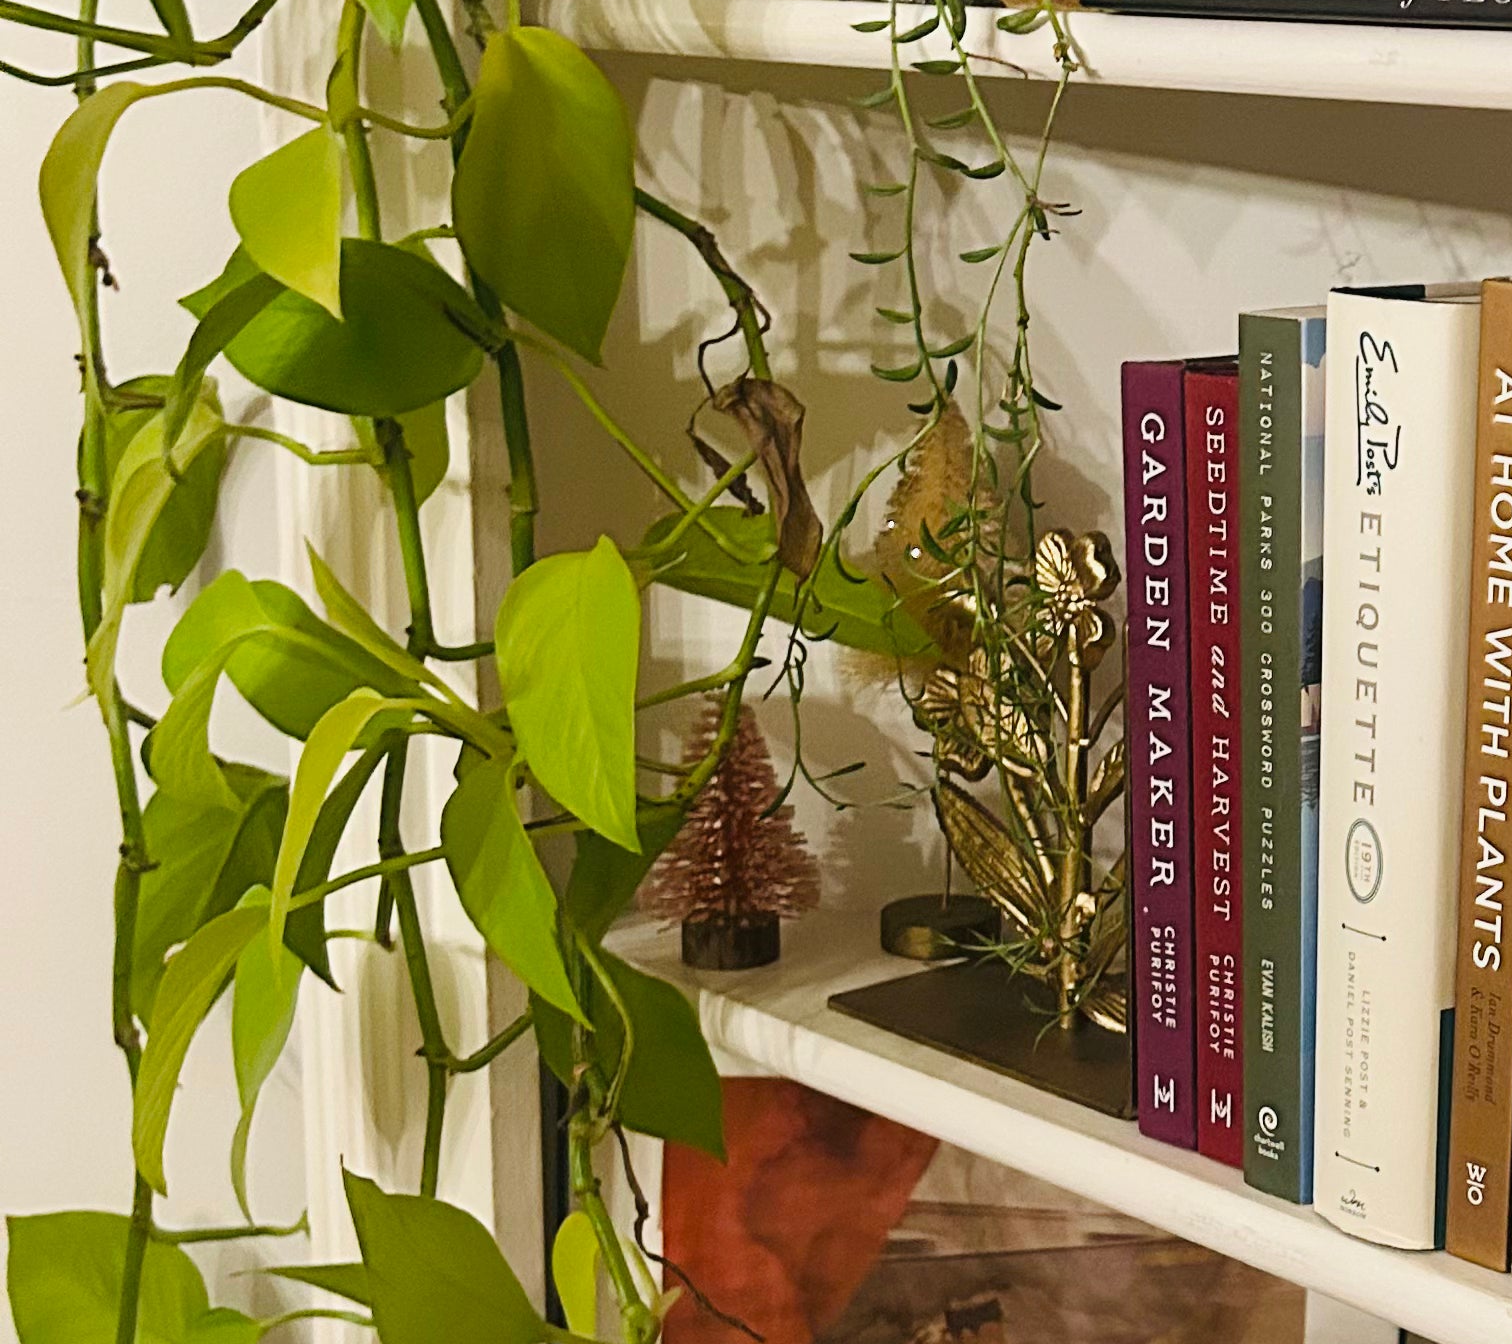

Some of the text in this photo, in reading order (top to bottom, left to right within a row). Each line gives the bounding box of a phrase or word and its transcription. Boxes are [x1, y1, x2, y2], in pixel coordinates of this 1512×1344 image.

[1359, 331, 1401, 496] Emily Post's
[1140, 411, 1175, 887] GARDEN MAKER
[1206, 405, 1231, 922] SEEDTIME and HARVEST
[1259, 352, 1273, 910] NATIONAL PARKS 300 CROSSWORD PUZZLES
[1353, 511, 1382, 806] ETIQUETTE
[1481, 627, 1512, 759] WITH
[1472, 775, 1508, 973] PLANTS
[1150, 926, 1163, 1024] PURIFOY
[1165, 926, 1176, 1029] CHRISTIE
[1209, 954, 1220, 1053] PURIFOY
[1223, 954, 1234, 1059] CHRISTIE
[1261, 958, 1275, 1053] EVAN KALISH
[1361, 989, 1370, 1044] LIZZIE
[1343, 951, 1356, 1138] DANIEL POST SENNING
[1360, 1050, 1369, 1093] POST
[1485, 1022, 1501, 1105] Drummond
